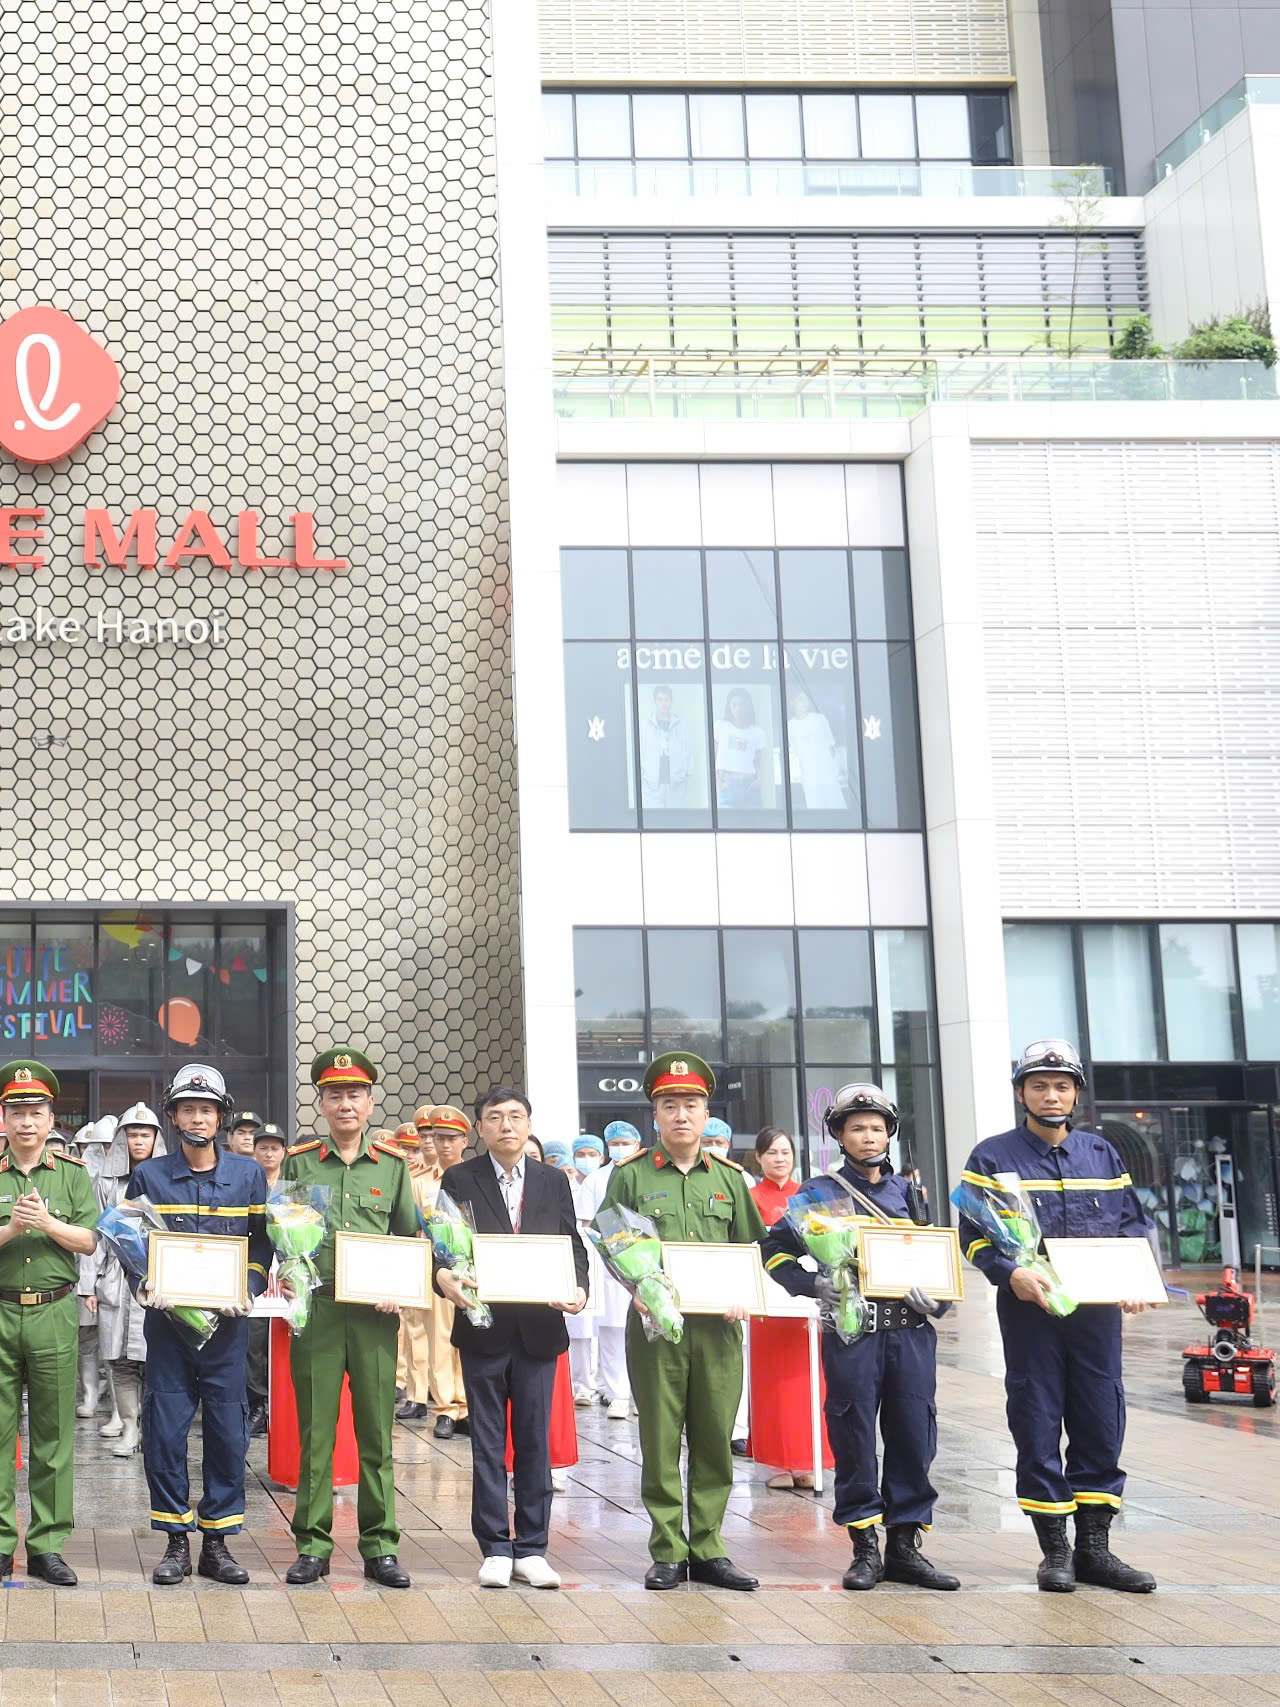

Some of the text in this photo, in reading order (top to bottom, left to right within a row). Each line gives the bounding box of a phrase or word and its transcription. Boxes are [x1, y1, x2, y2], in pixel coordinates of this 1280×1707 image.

[83, 508, 347, 570] MALL
[96, 609, 223, 645] Hanoi
[712, 644, 751, 670] de
[800, 646, 849, 670] vie
[598, 1078, 644, 1092] CO
